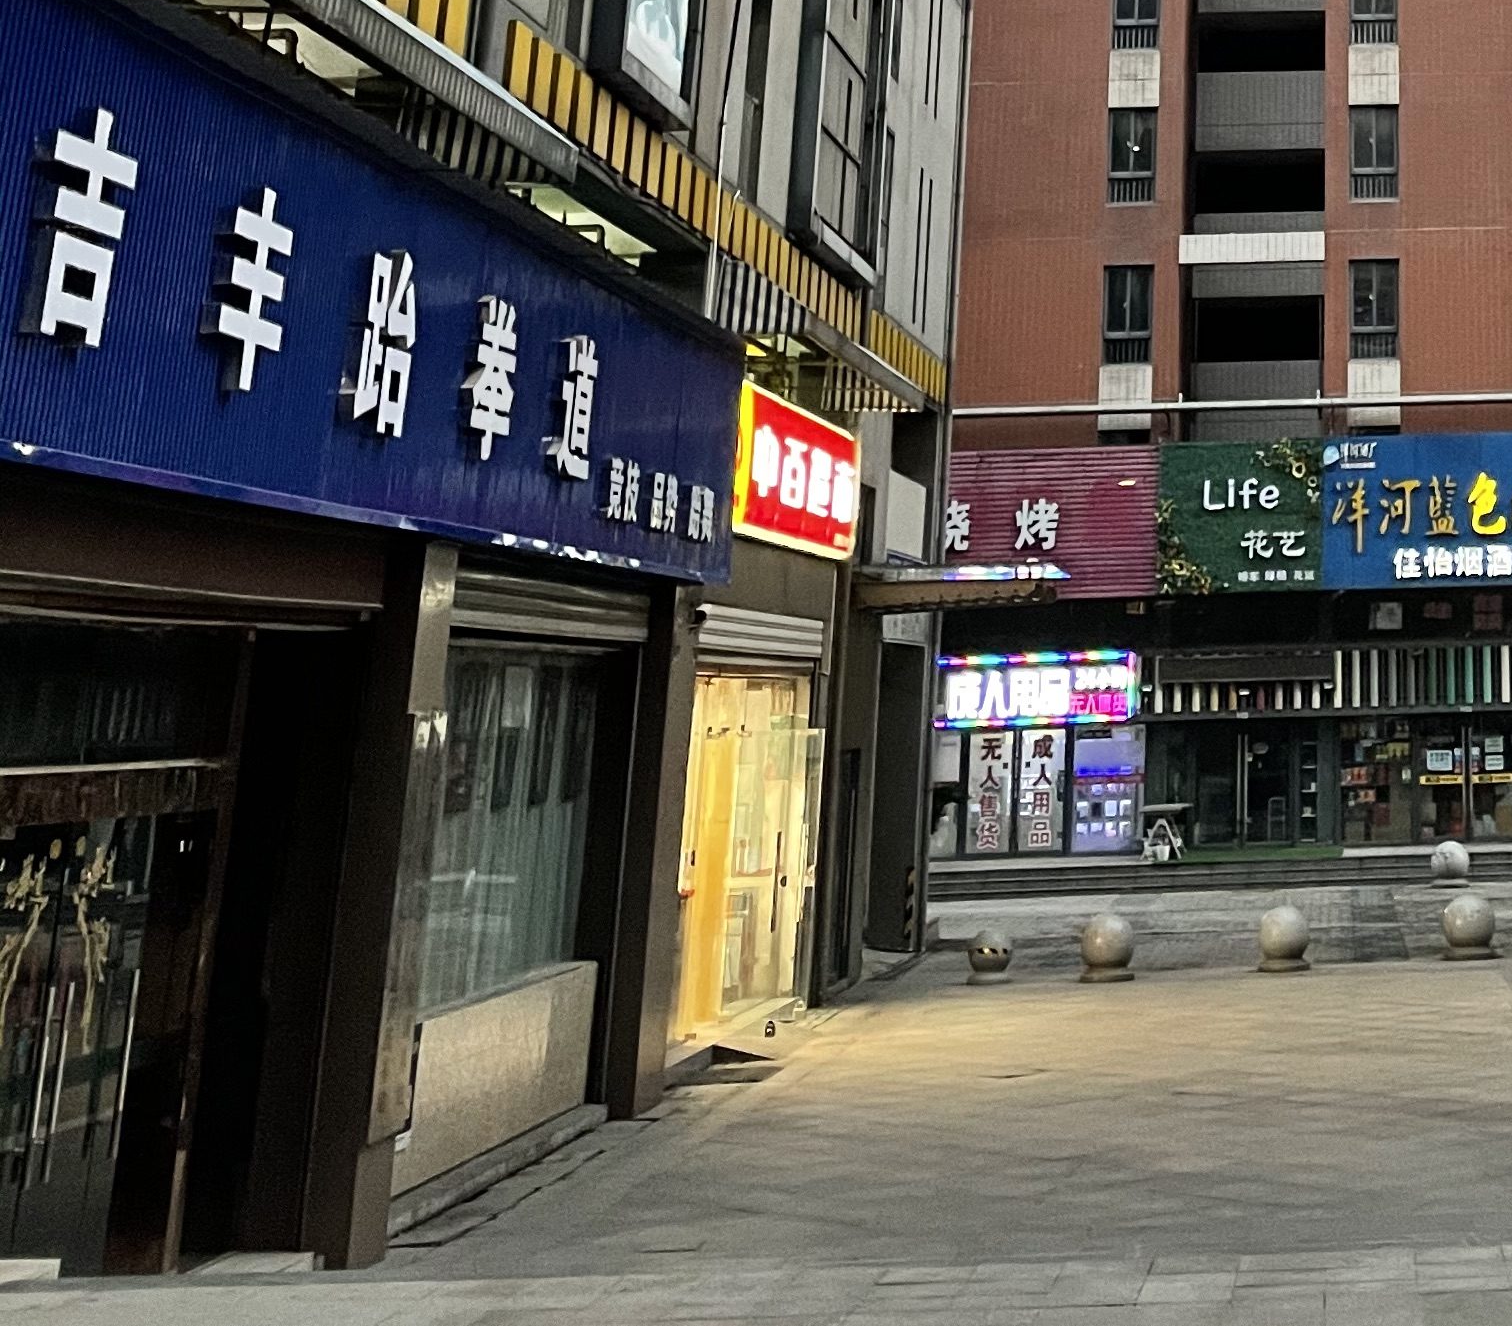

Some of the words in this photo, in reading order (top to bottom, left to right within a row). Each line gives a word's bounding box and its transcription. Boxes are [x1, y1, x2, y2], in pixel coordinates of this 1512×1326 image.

[40, 107, 599, 480] 吉丰跆拳道
[1203, 477, 1280, 510] Life
[1240, 529, 1306, 559] 花艺
[947, 668, 1071, 719] 成人用品
[977, 736, 1002, 849] 无人售货
[1029, 734, 1055, 847] 成人用品
